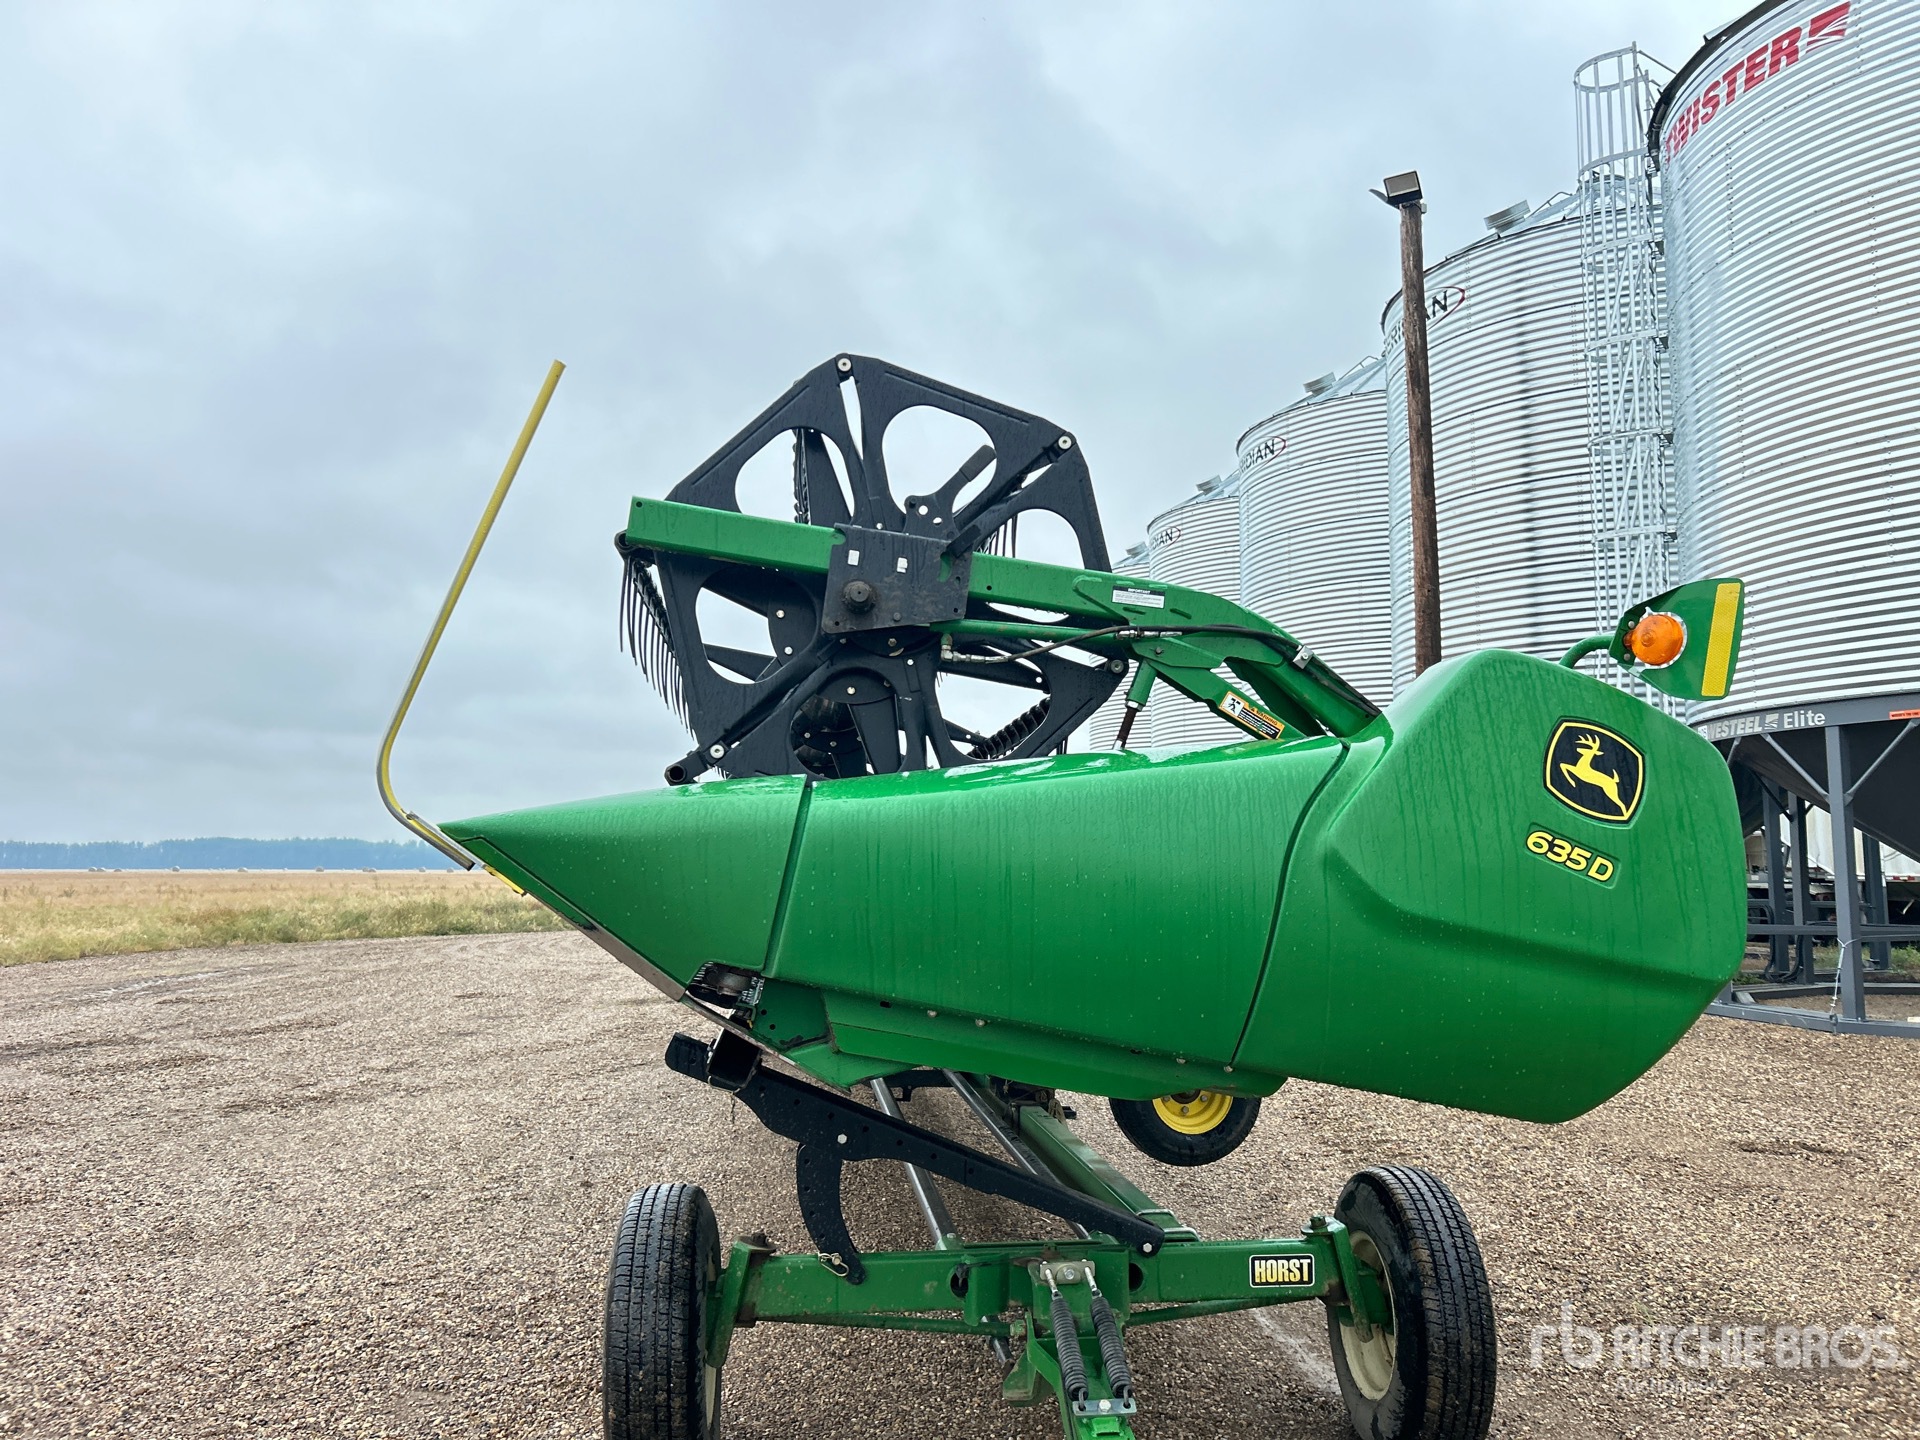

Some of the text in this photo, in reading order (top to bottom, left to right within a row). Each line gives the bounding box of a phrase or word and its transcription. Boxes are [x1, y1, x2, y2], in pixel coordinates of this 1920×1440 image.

[1665, 26, 1803, 164] TWISTER
[1256, 710, 1278, 726] WARNING
[1783, 709, 1826, 728] Elite
[1254, 1258, 1311, 1283] HORST
